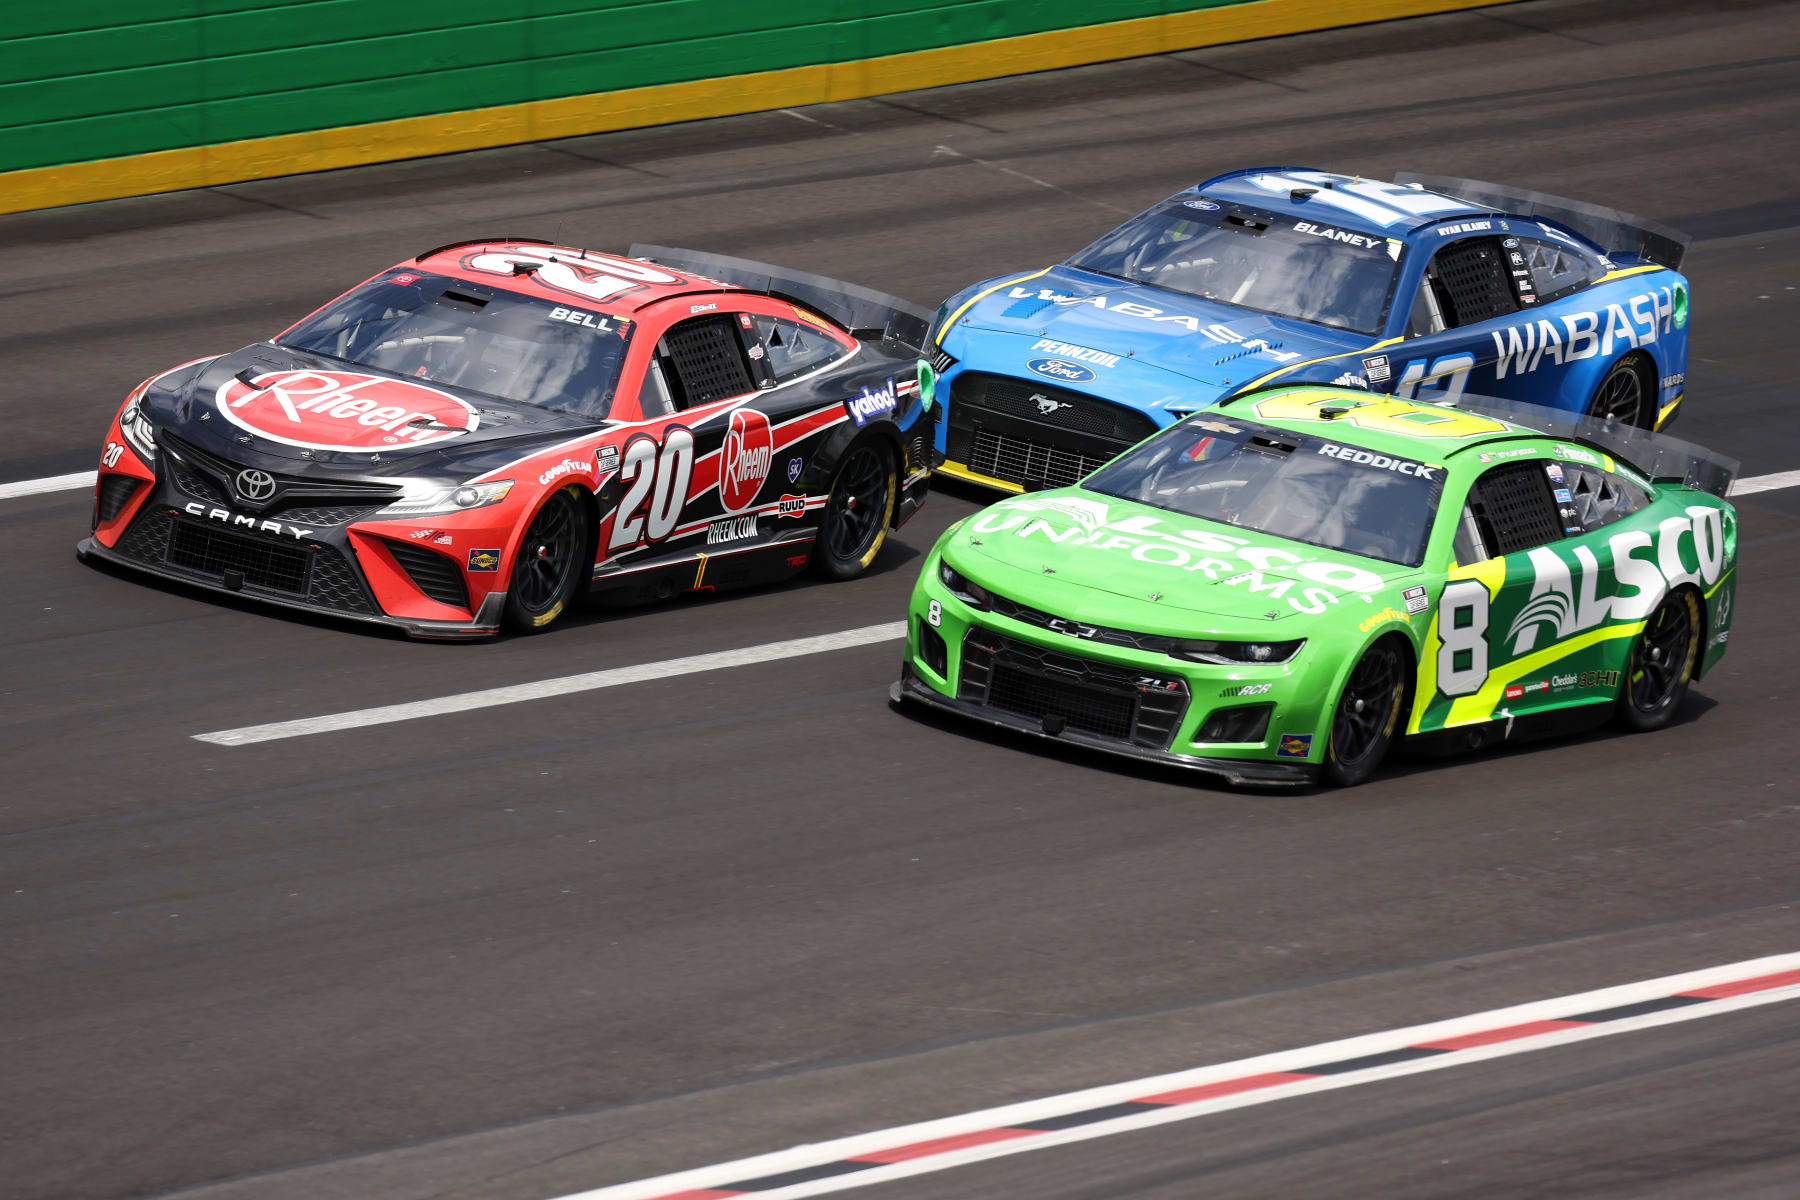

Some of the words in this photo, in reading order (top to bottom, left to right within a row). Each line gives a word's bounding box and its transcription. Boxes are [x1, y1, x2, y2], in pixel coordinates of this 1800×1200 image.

[1293, 222, 1381, 249] BLANEY
[1437, 225, 1461, 236] RYAN
[461, 245, 677, 300] 20
[549, 306, 613, 332] BELL
[1008, 286, 1301, 363] WABASH
[1491, 286, 1674, 380] WABASH
[1031, 339, 1122, 368] PENNZOIL
[1037, 360, 1083, 379] Ford
[229, 371, 443, 443] Rheem
[849, 379, 897, 423] yahoo!
[102, 442, 123, 469] 20
[539, 459, 592, 485] GOODYEAR
[722, 427, 770, 497] Rheem
[1318, 444, 1435, 481] REDDICK
[608, 429, 694, 550] 20
[779, 500, 806, 512] RUUD
[185, 502, 313, 540] CAMRY
[707, 515, 759, 545] RHEEM.COM
[997, 496, 1384, 593] ALSCO
[972, 513, 1339, 614] UNIFORMS
[1503, 506, 1723, 656] ALSCO
[928, 599, 942, 628] 8
[1438, 580, 1490, 696] 8
[1579, 671, 1621, 688] 3CHI
